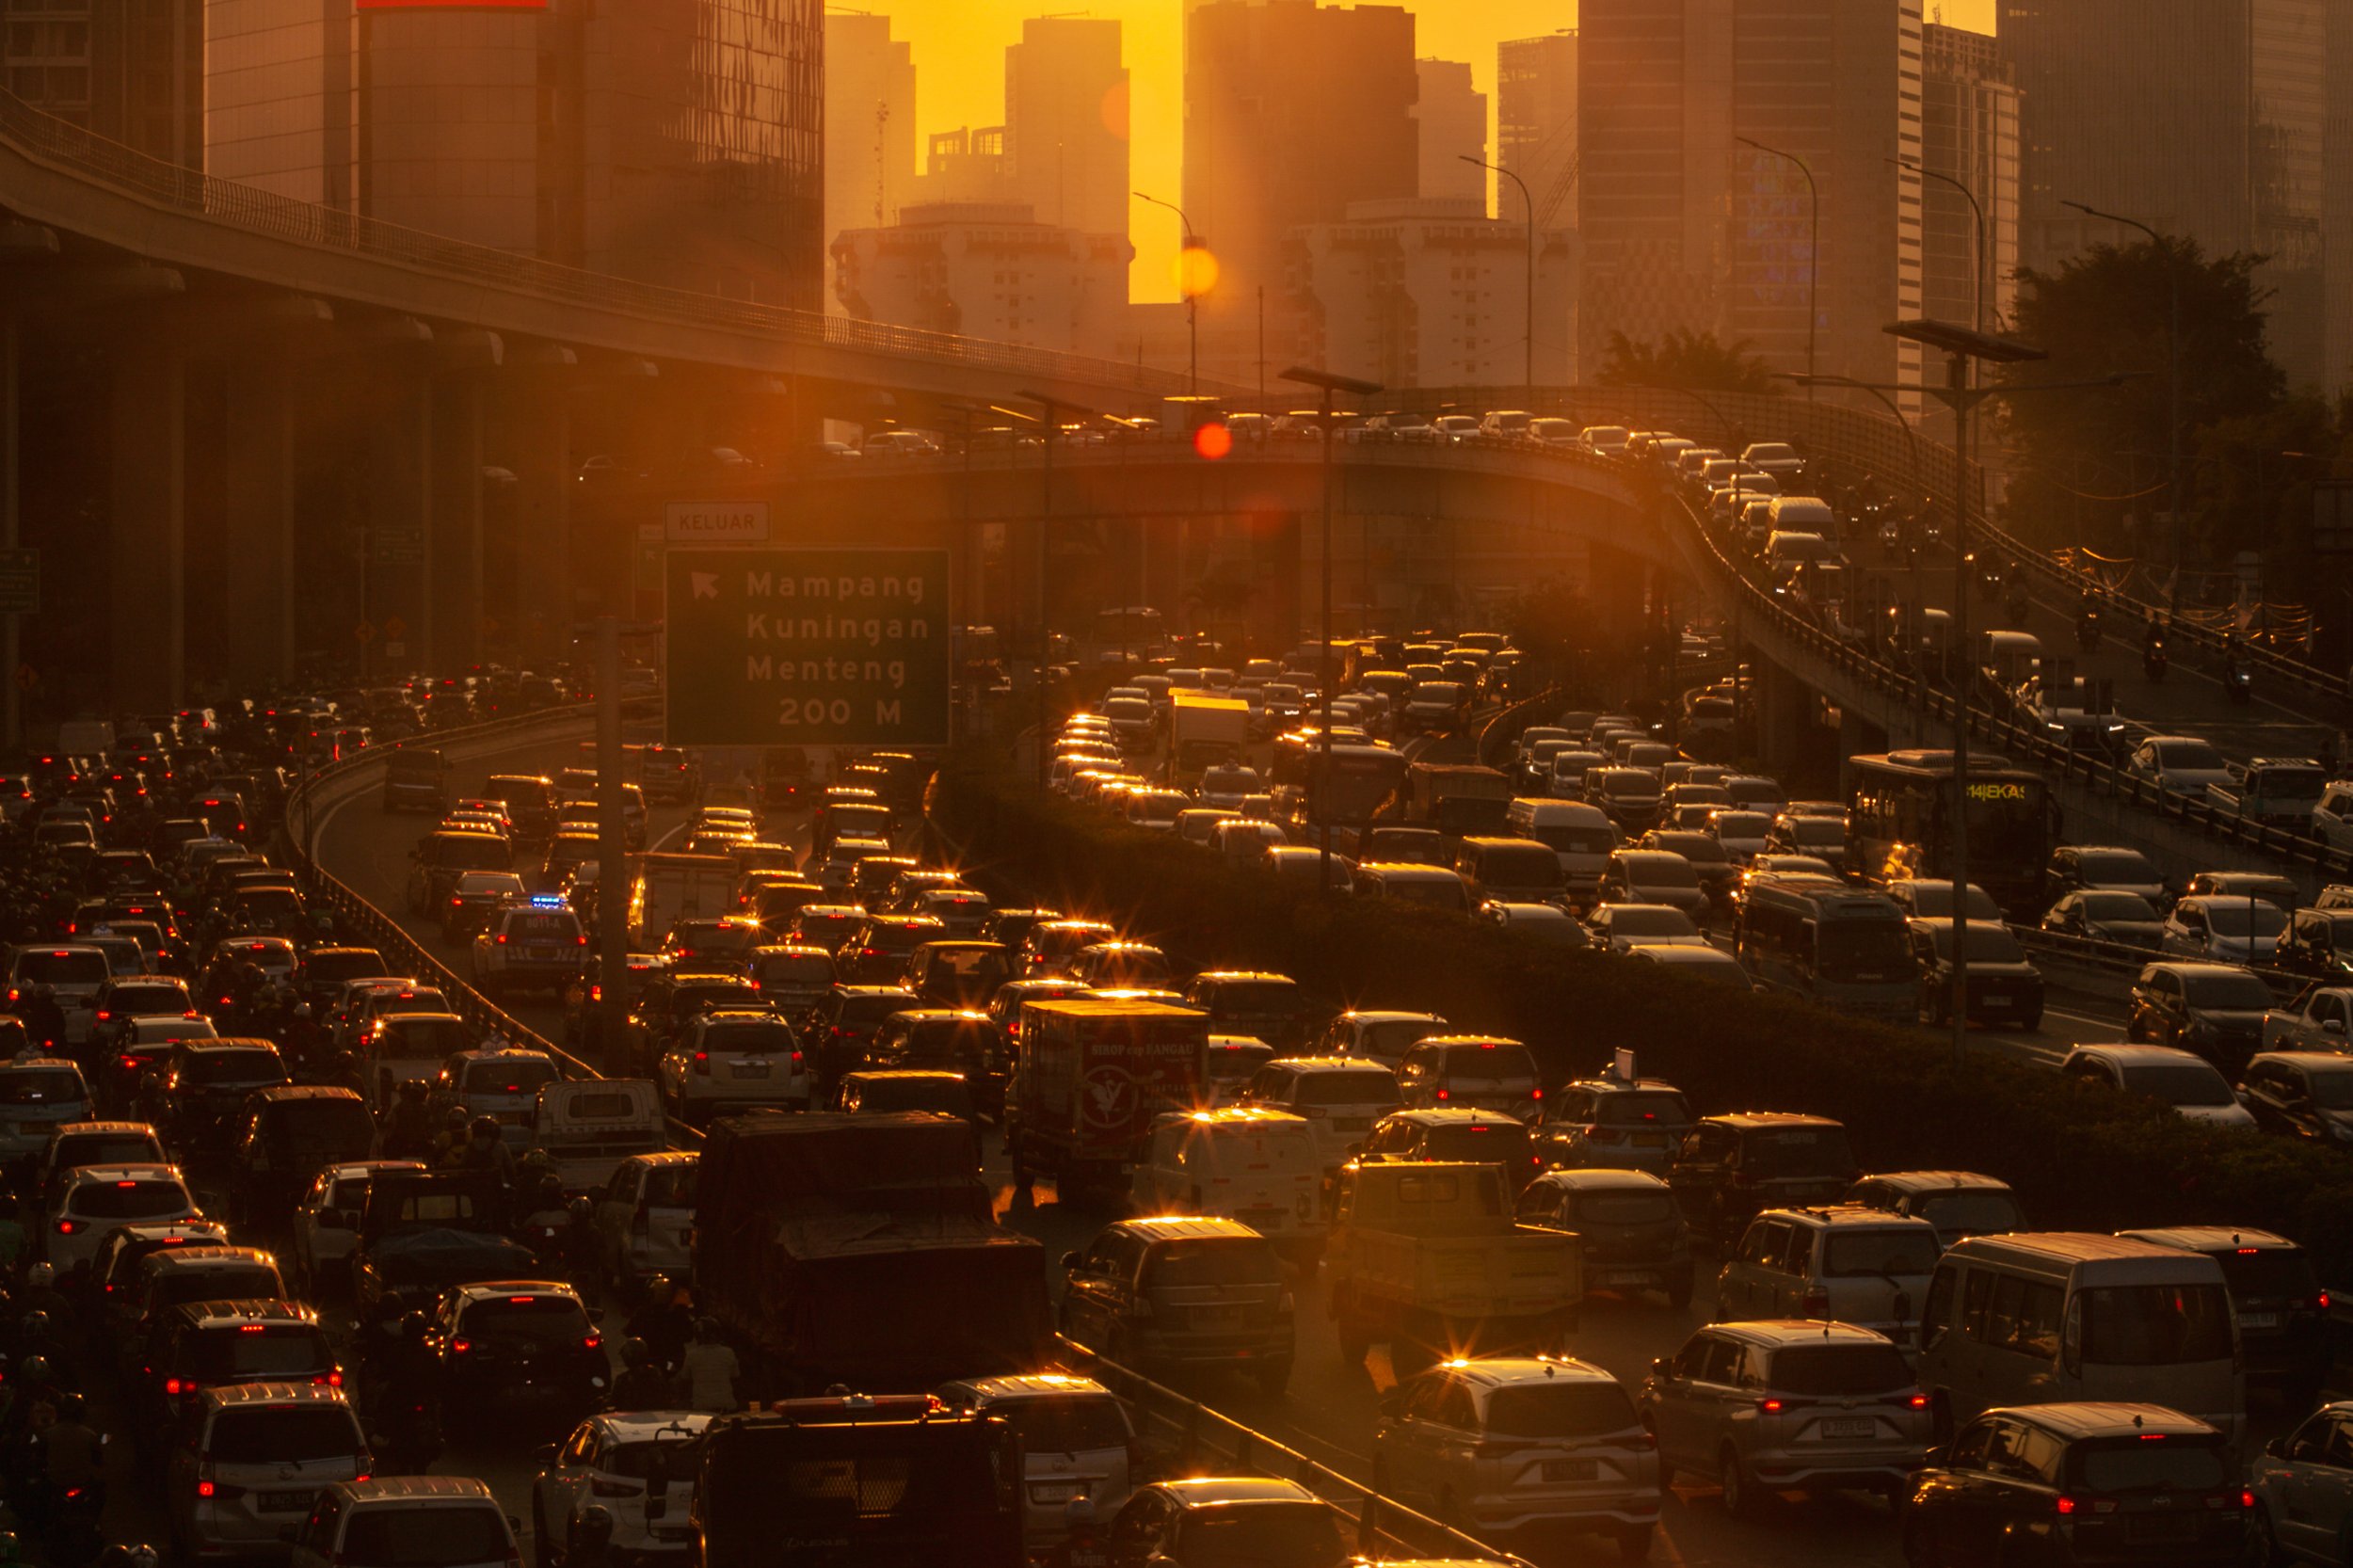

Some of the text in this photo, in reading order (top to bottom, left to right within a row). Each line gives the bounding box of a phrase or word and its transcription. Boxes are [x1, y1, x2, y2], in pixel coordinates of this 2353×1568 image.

[680, 514, 755, 531] KELUAR
[746, 571, 924, 604] Mampang
[746, 614, 929, 647] Kuningan
[746, 655, 906, 688] Menteng
[779, 698, 902, 726] 200 M
[1091, 1044, 1126, 1056] SIROP
